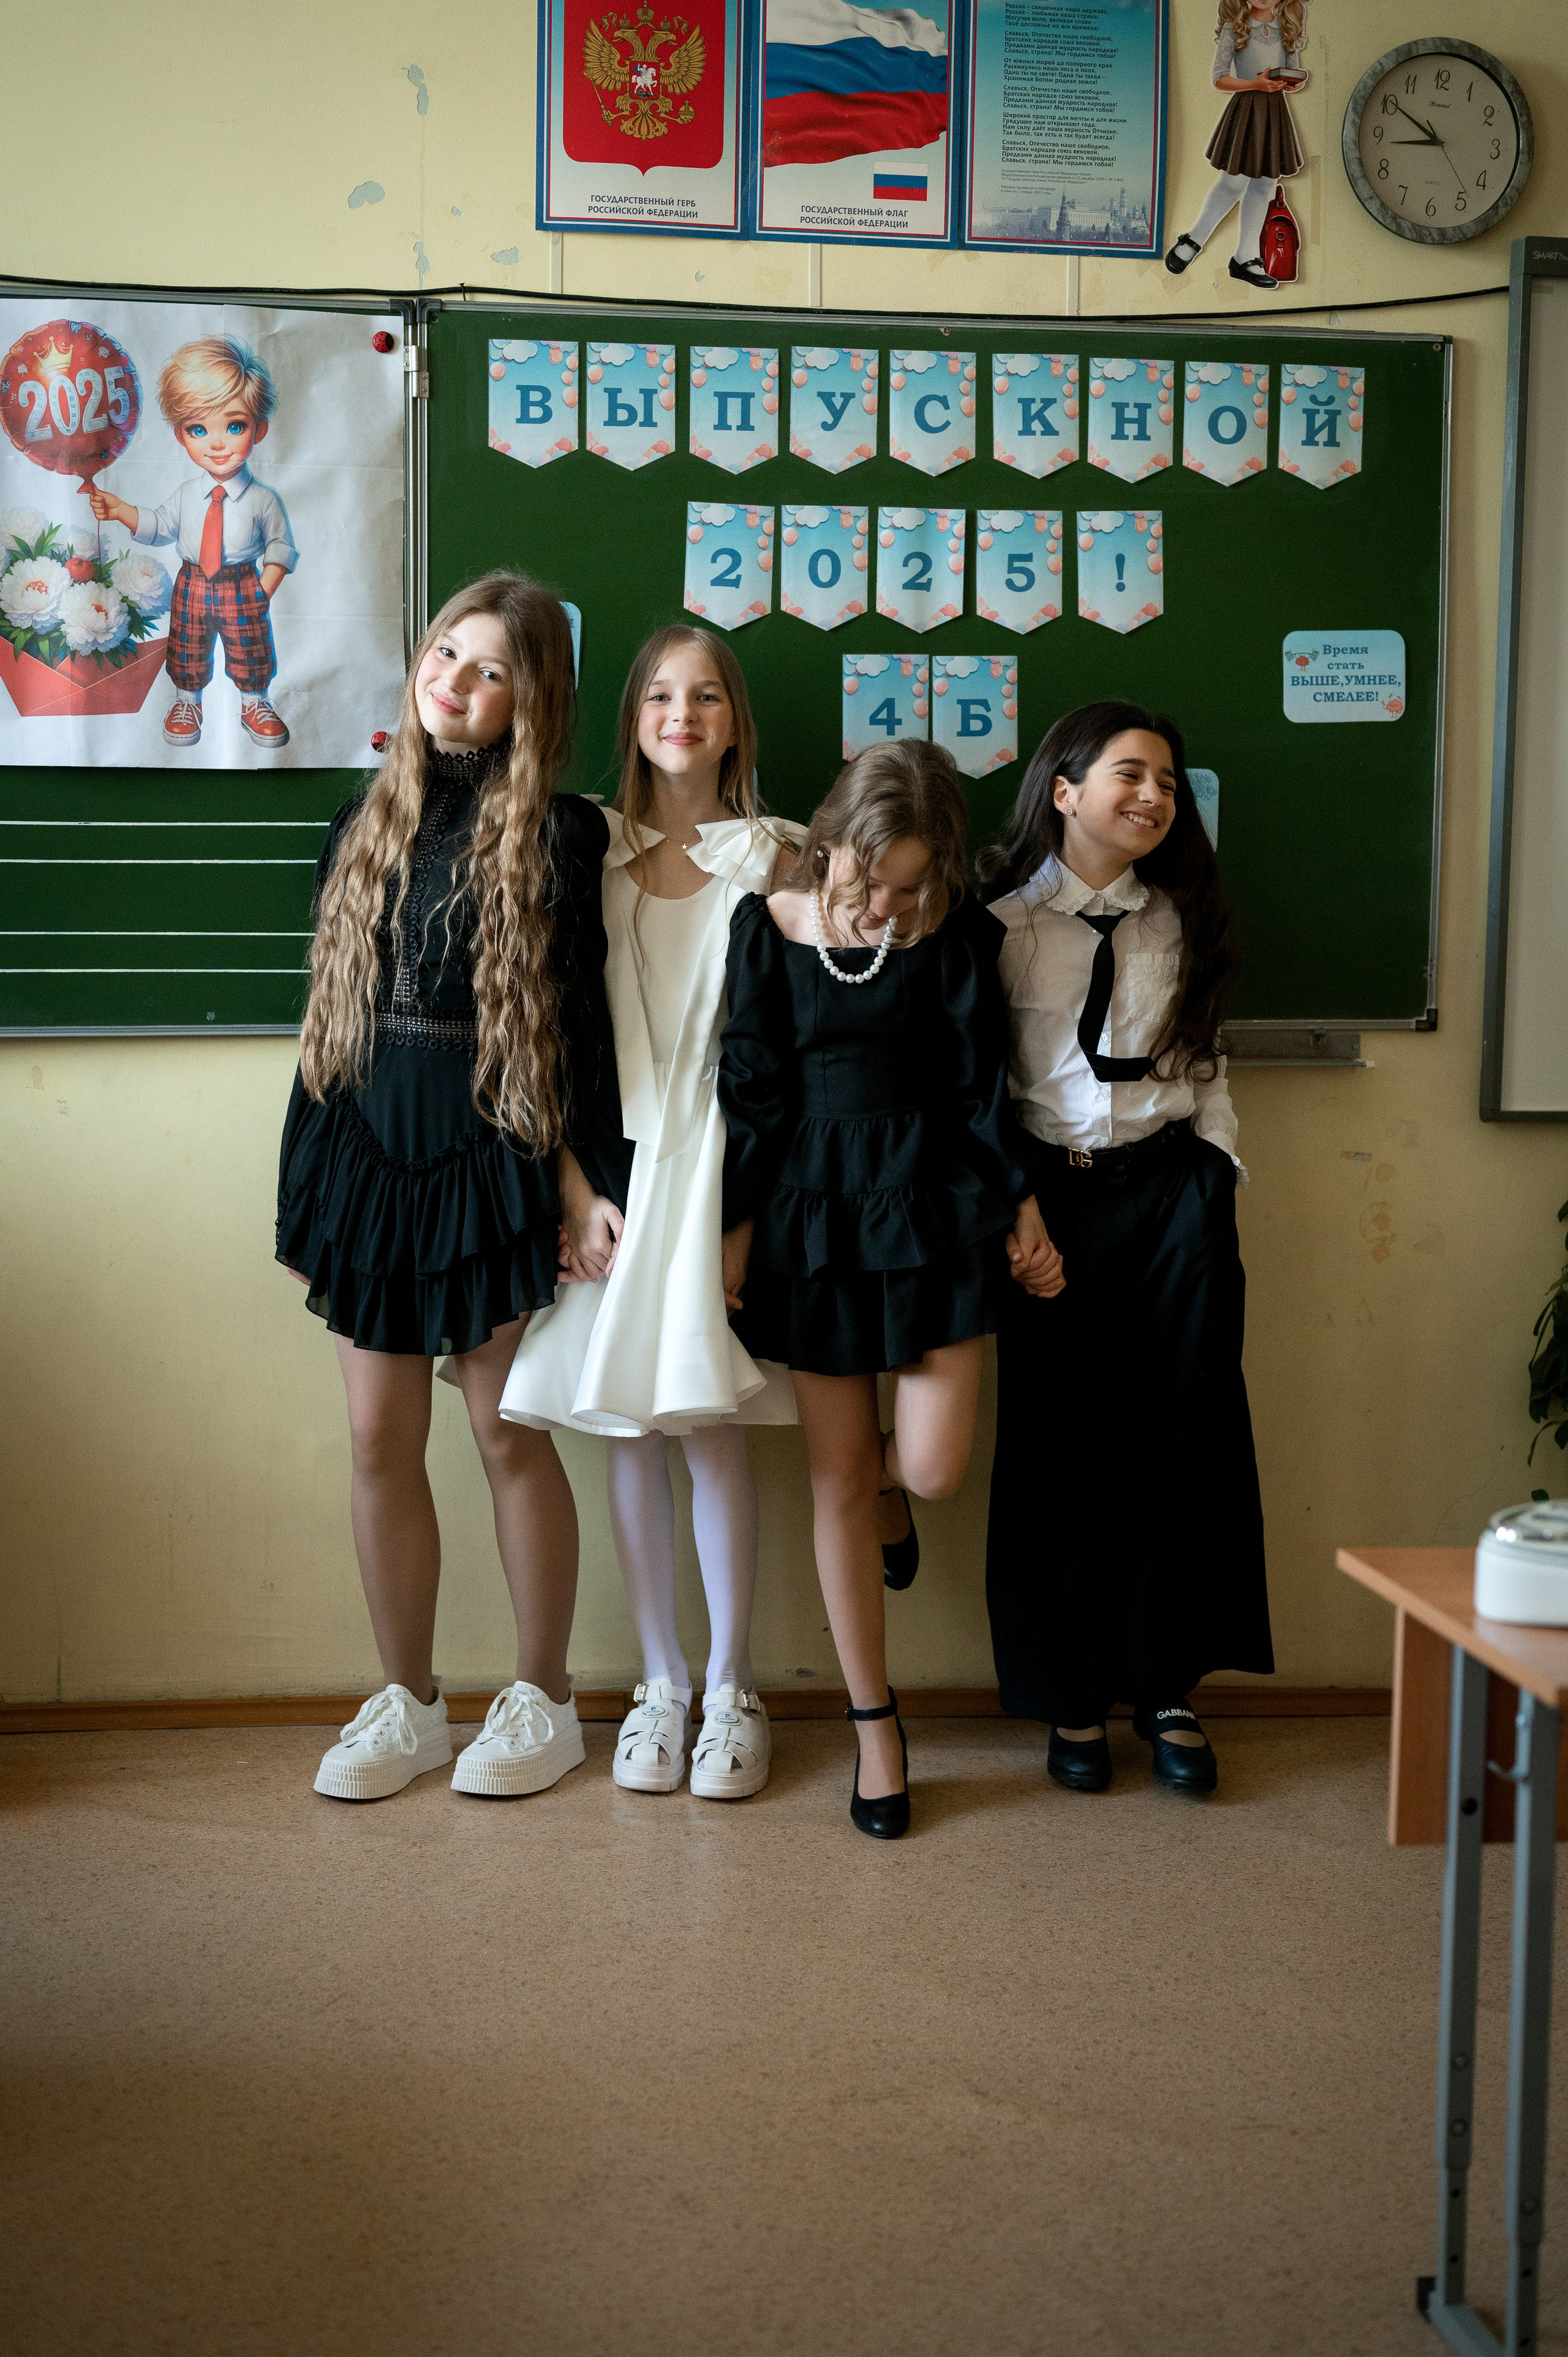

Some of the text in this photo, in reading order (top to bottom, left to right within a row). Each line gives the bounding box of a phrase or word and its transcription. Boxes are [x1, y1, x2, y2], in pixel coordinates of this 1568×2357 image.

[1404, 74, 1417, 95] 11
[1434, 69, 1450, 91] 12
[1467, 81, 1474, 102] 1
[1381, 93, 1398, 115] 10
[1483, 105, 1494, 127] 2
[1373, 126, 1384, 145] 9
[1490, 138, 1501, 160] 3
[1378, 159, 1389, 179] 8
[1476, 170, 1487, 190] 4
[590, 195, 674, 206] ГОСУДАРСТВЕННЫЙ
[1398, 184, 1408, 205] 7
[1455, 191, 1467, 211] 5
[588, 205, 698, 219] РОССИЙСКОЙ ФЕДЕРАЦИИ
[801, 205, 883, 216] ГОСУДАРСТВЕННЫЙ
[1425, 196, 1436, 217] 6
[800, 216, 908, 228] РОССИЙСКОЙ ФЕДЕРАЦИИ
[1533, 251, 1559, 260] SMART
[18, 366, 130, 443] 2025
[515, 384, 1342, 448] ВЫПУСКНОЙ
[1322, 644, 1369, 657] Время
[1313, 691, 1378, 702] СМЕЛЕЕ!
